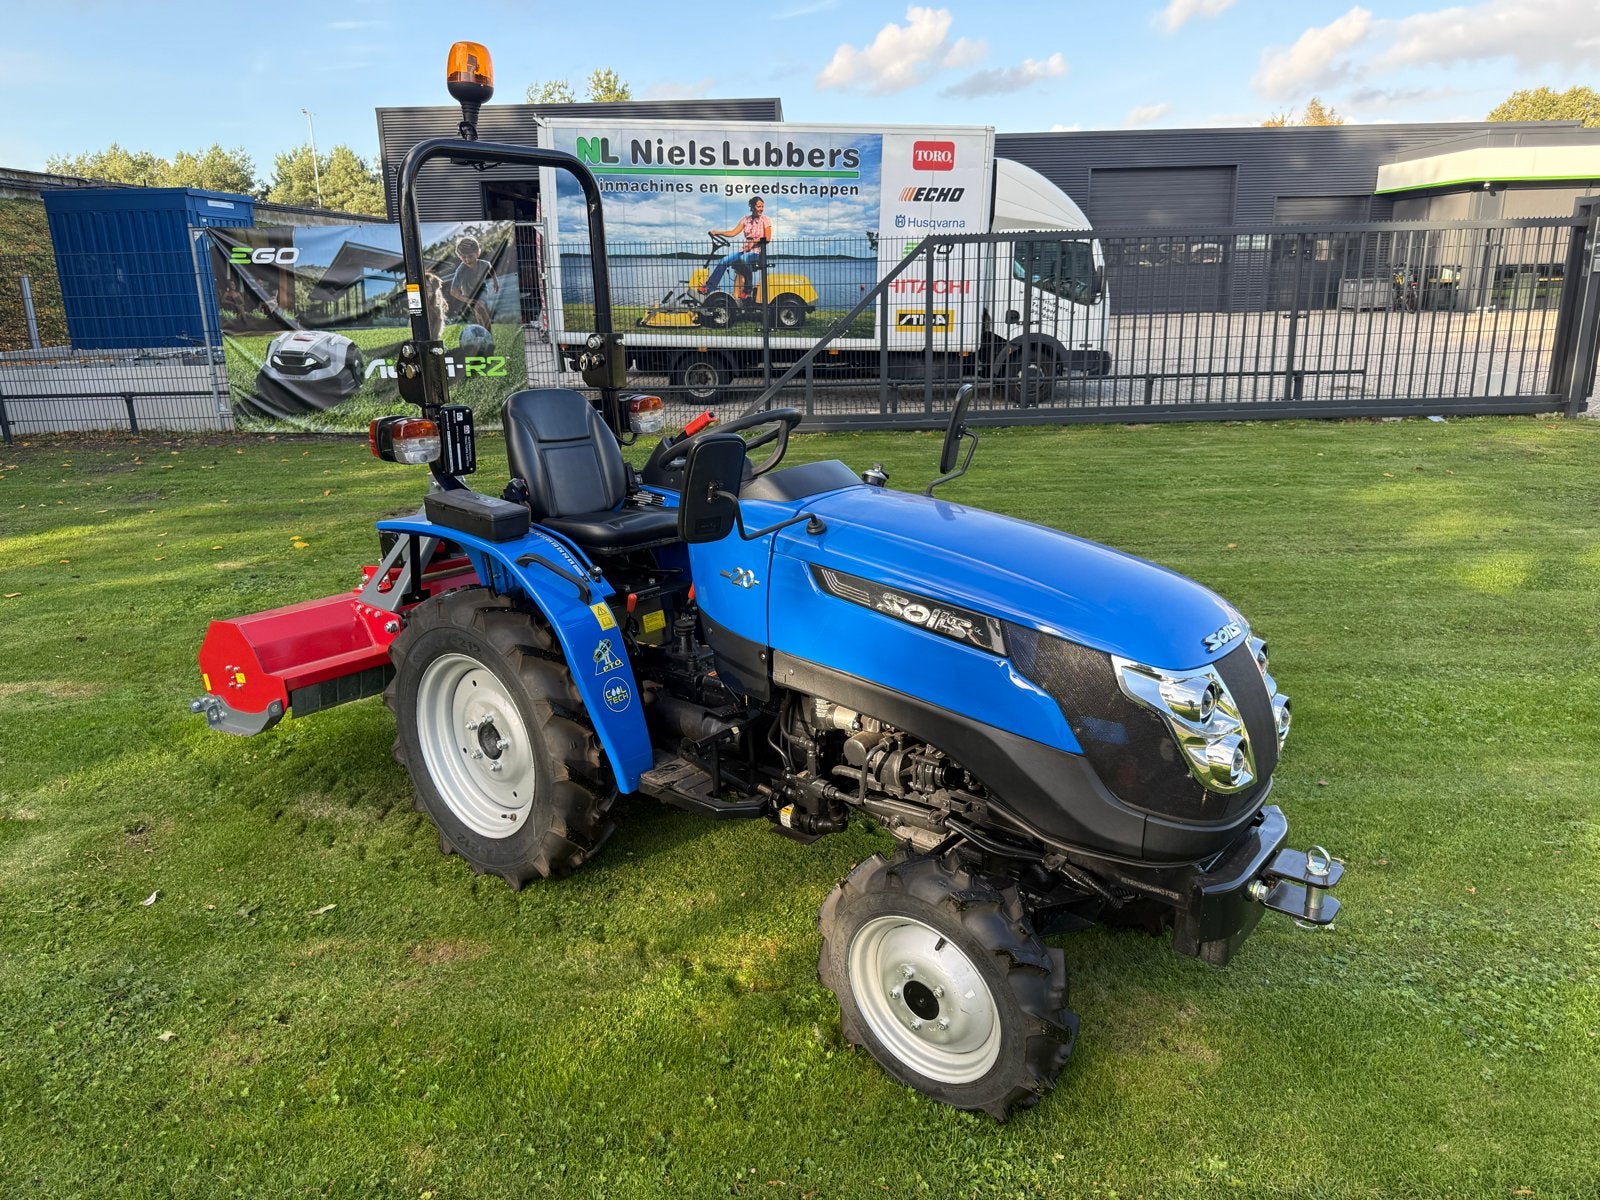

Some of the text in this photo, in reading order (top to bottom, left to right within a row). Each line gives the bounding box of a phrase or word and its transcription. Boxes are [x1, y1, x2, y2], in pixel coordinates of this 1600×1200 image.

[576, 136, 619, 164] NL
[915, 150, 952, 162] TORO
[590, 178, 859, 198] inmachines en gereedschappen
[912, 187, 965, 202] ECHO
[907, 217, 966, 232] Husqvarna
[229, 247, 300, 264] EGO
[899, 314, 947, 326] STIA
[603, 659, 622, 672] PTO
[607, 693, 629, 705] TECH
